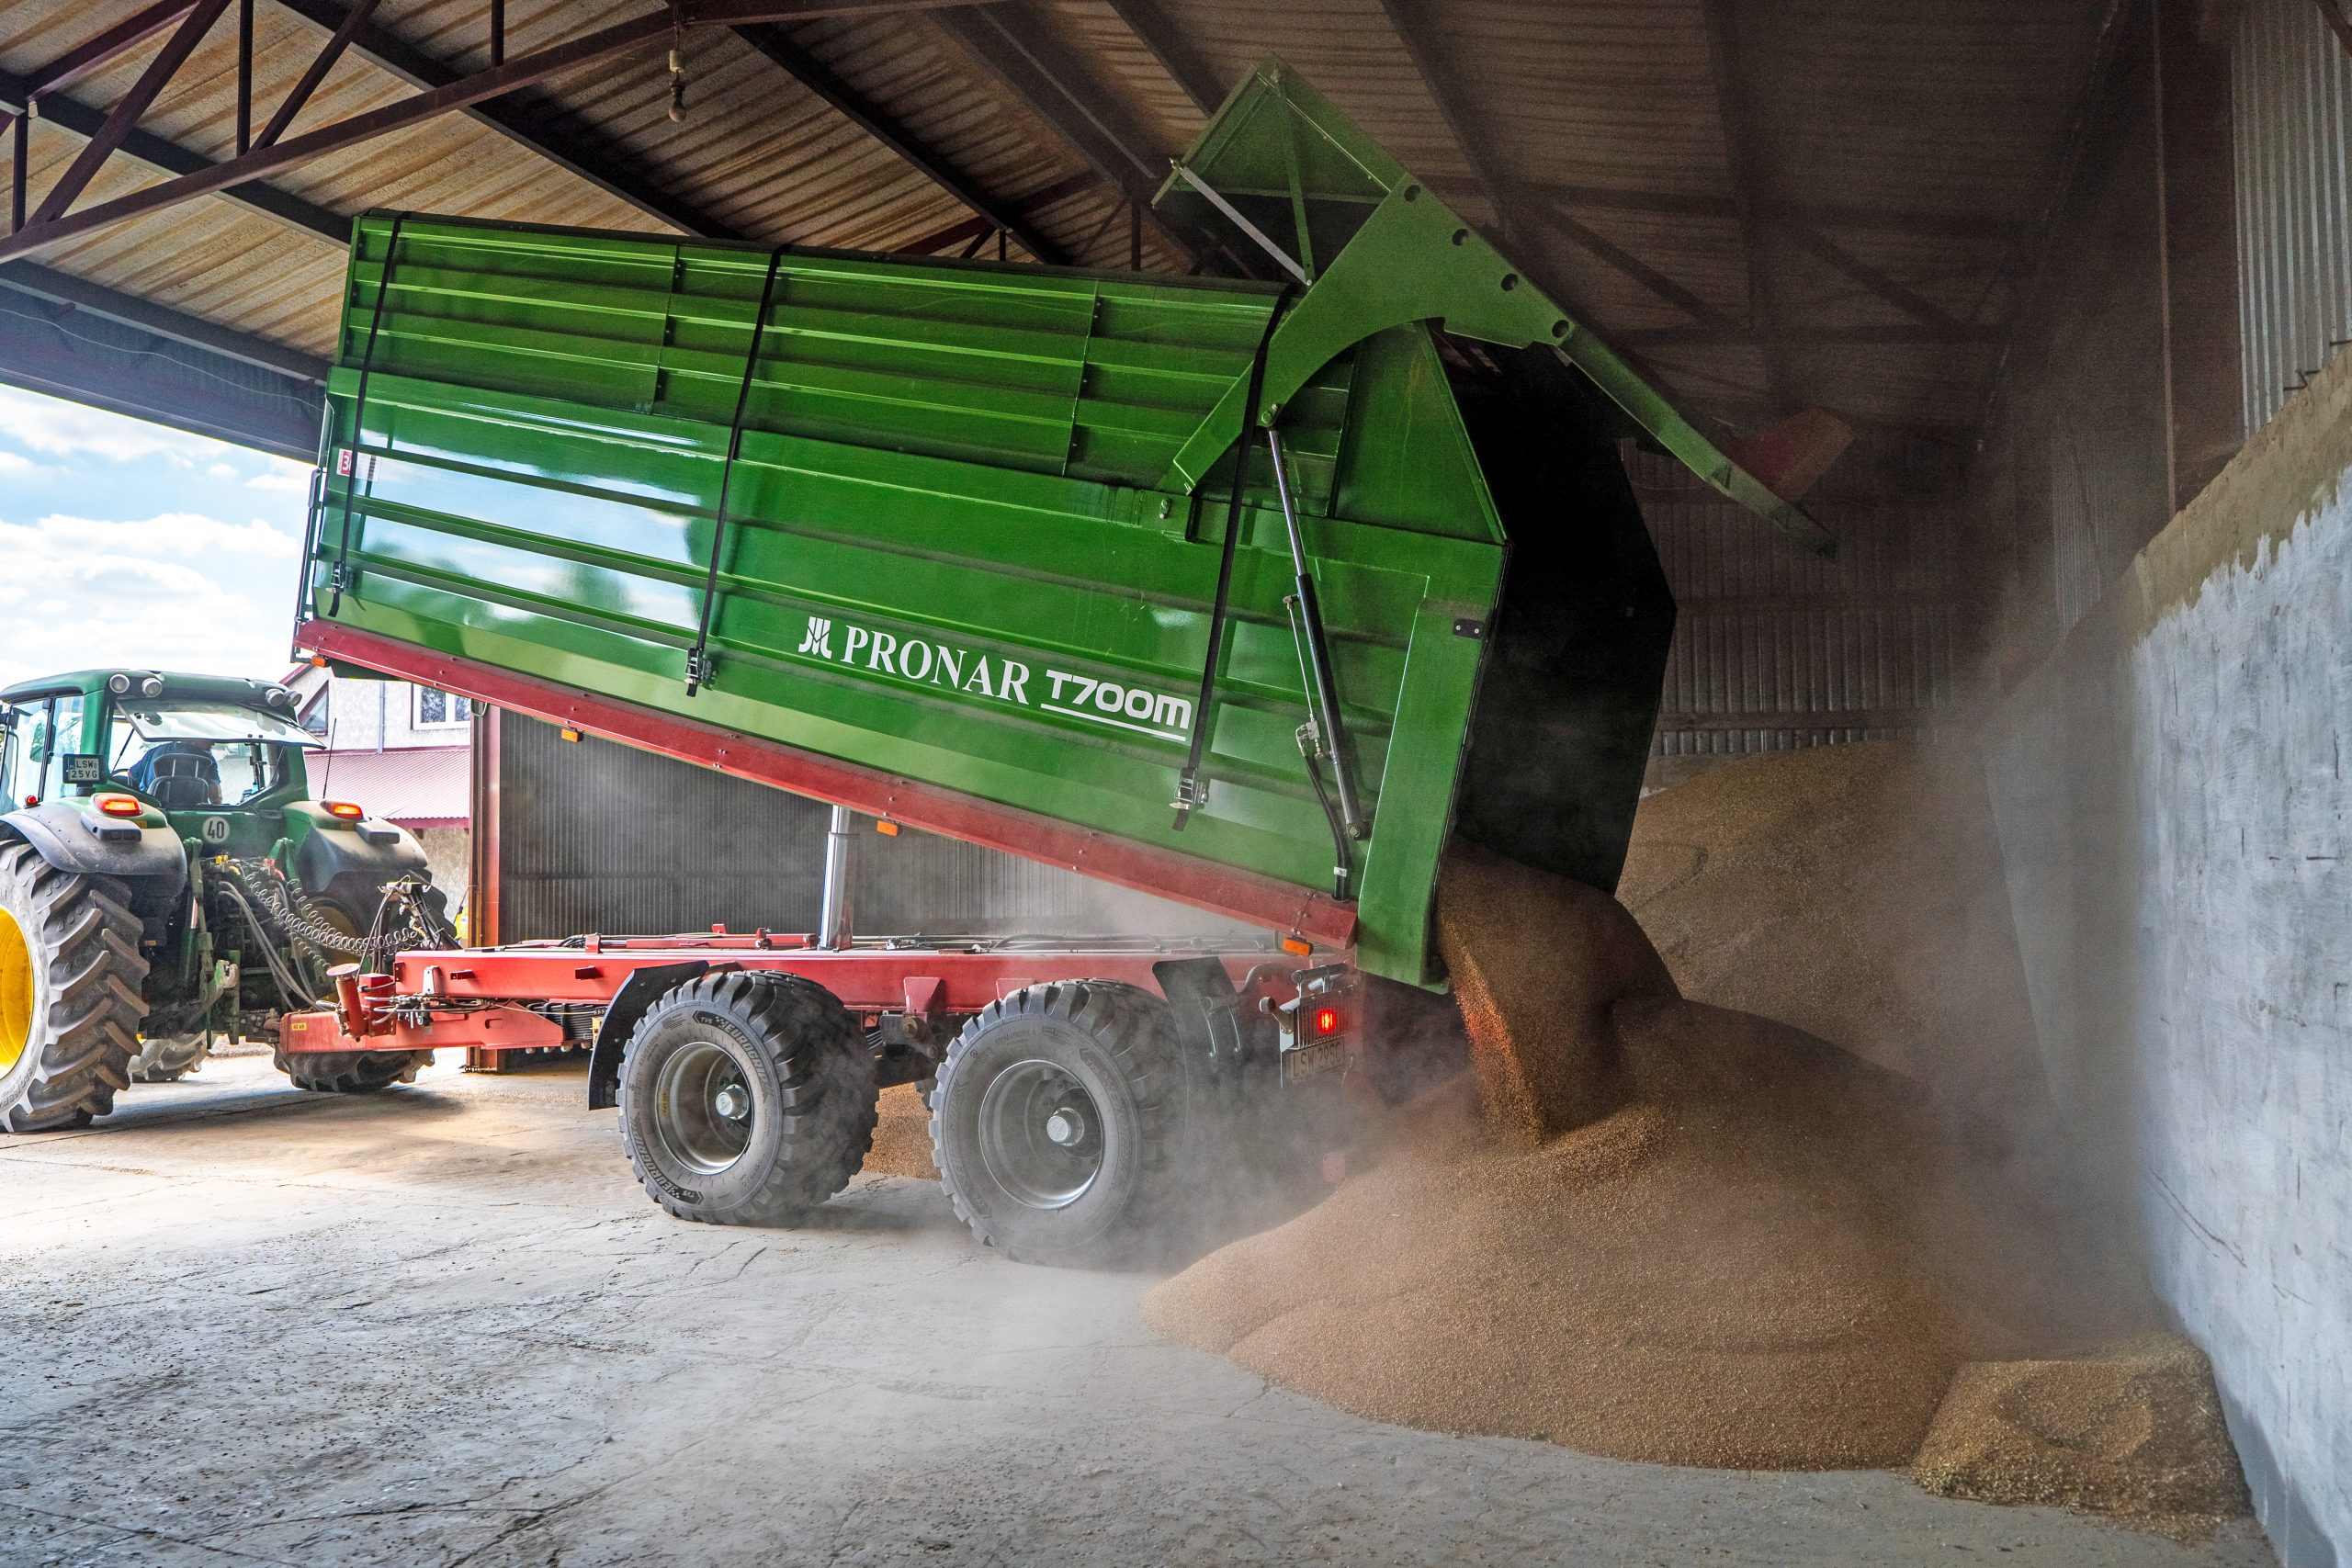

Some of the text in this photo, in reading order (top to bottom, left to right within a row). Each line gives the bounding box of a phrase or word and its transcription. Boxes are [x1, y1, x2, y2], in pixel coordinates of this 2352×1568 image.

[840, 625, 1030, 705] PRONAR
[71, 770, 97, 778] 25VG
[76, 761, 94, 769] LSW
[208, 820, 225, 839] 40
[723, 1021, 769, 1083] EUROGRIP
[1293, 1049, 1314, 1077] LSW
[632, 1130, 673, 1191] EUROGRIP
